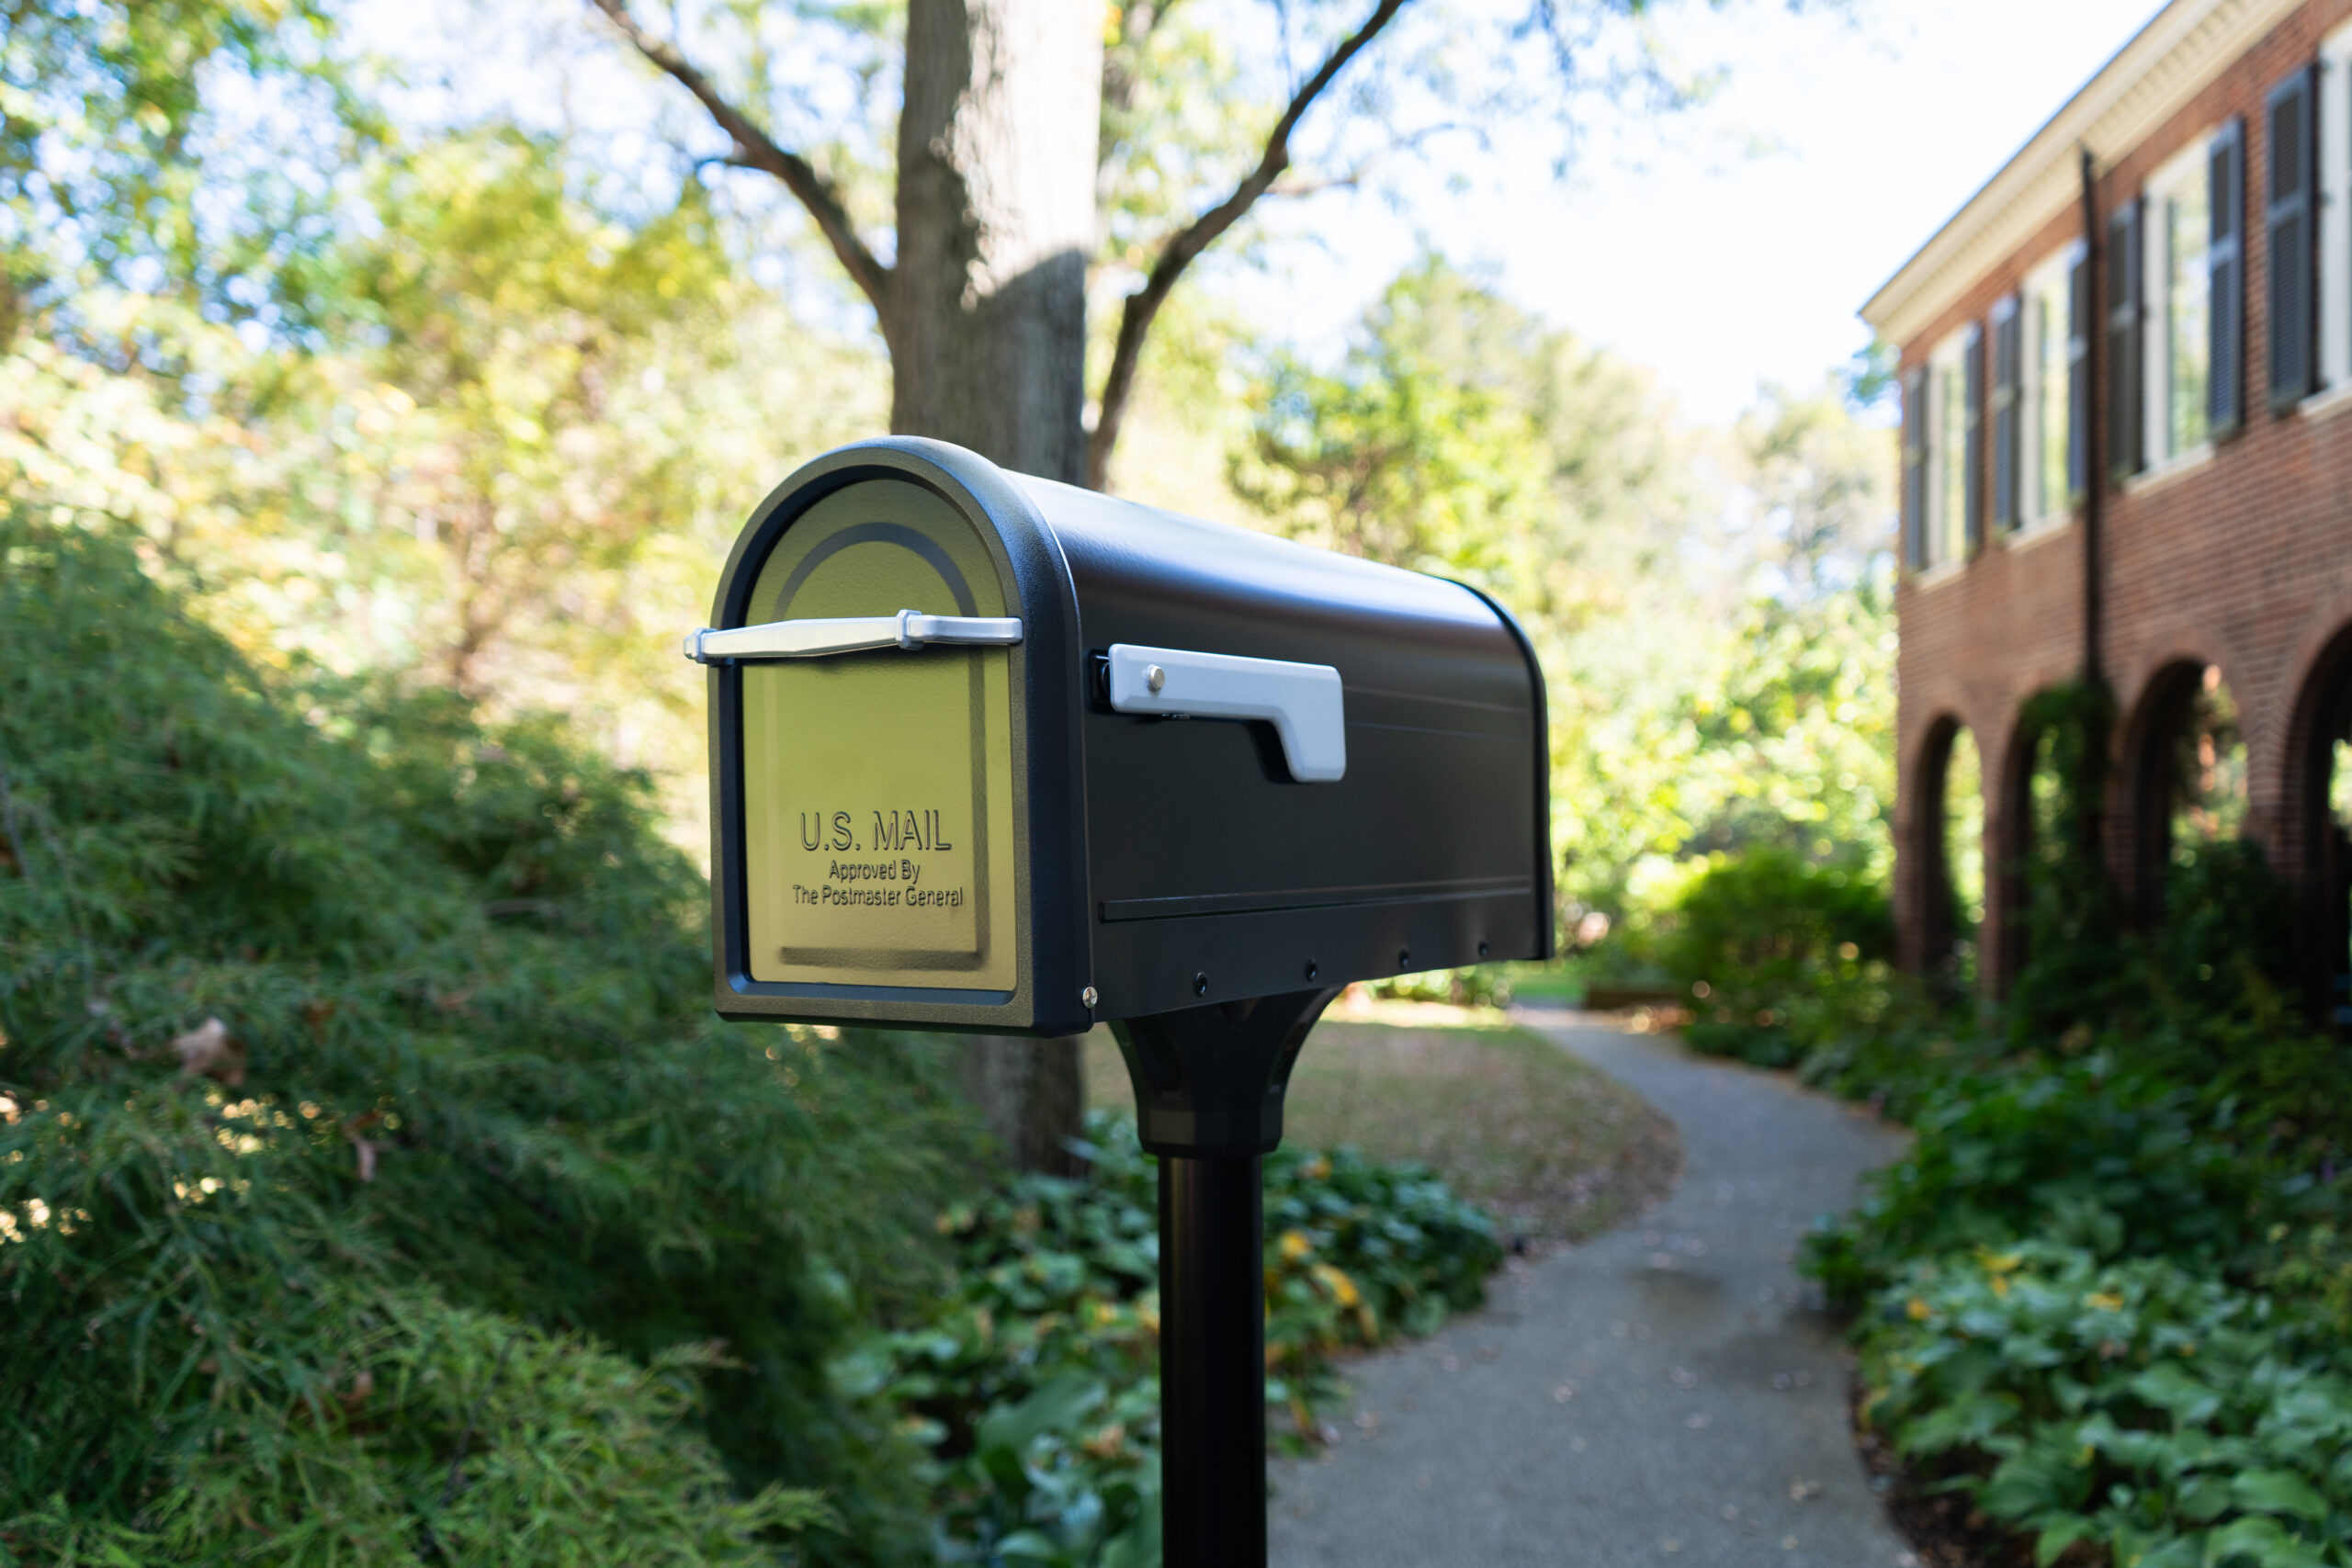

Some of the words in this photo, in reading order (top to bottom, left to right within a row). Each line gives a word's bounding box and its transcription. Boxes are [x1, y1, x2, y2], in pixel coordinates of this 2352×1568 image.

[800, 811, 861, 852] U.S.
[873, 809, 953, 851] MAIL
[829, 860, 897, 884] Approved
[900, 859, 921, 885] By
[793, 885, 819, 905] The
[822, 885, 901, 906] Postmaster
[905, 886, 963, 907] General
